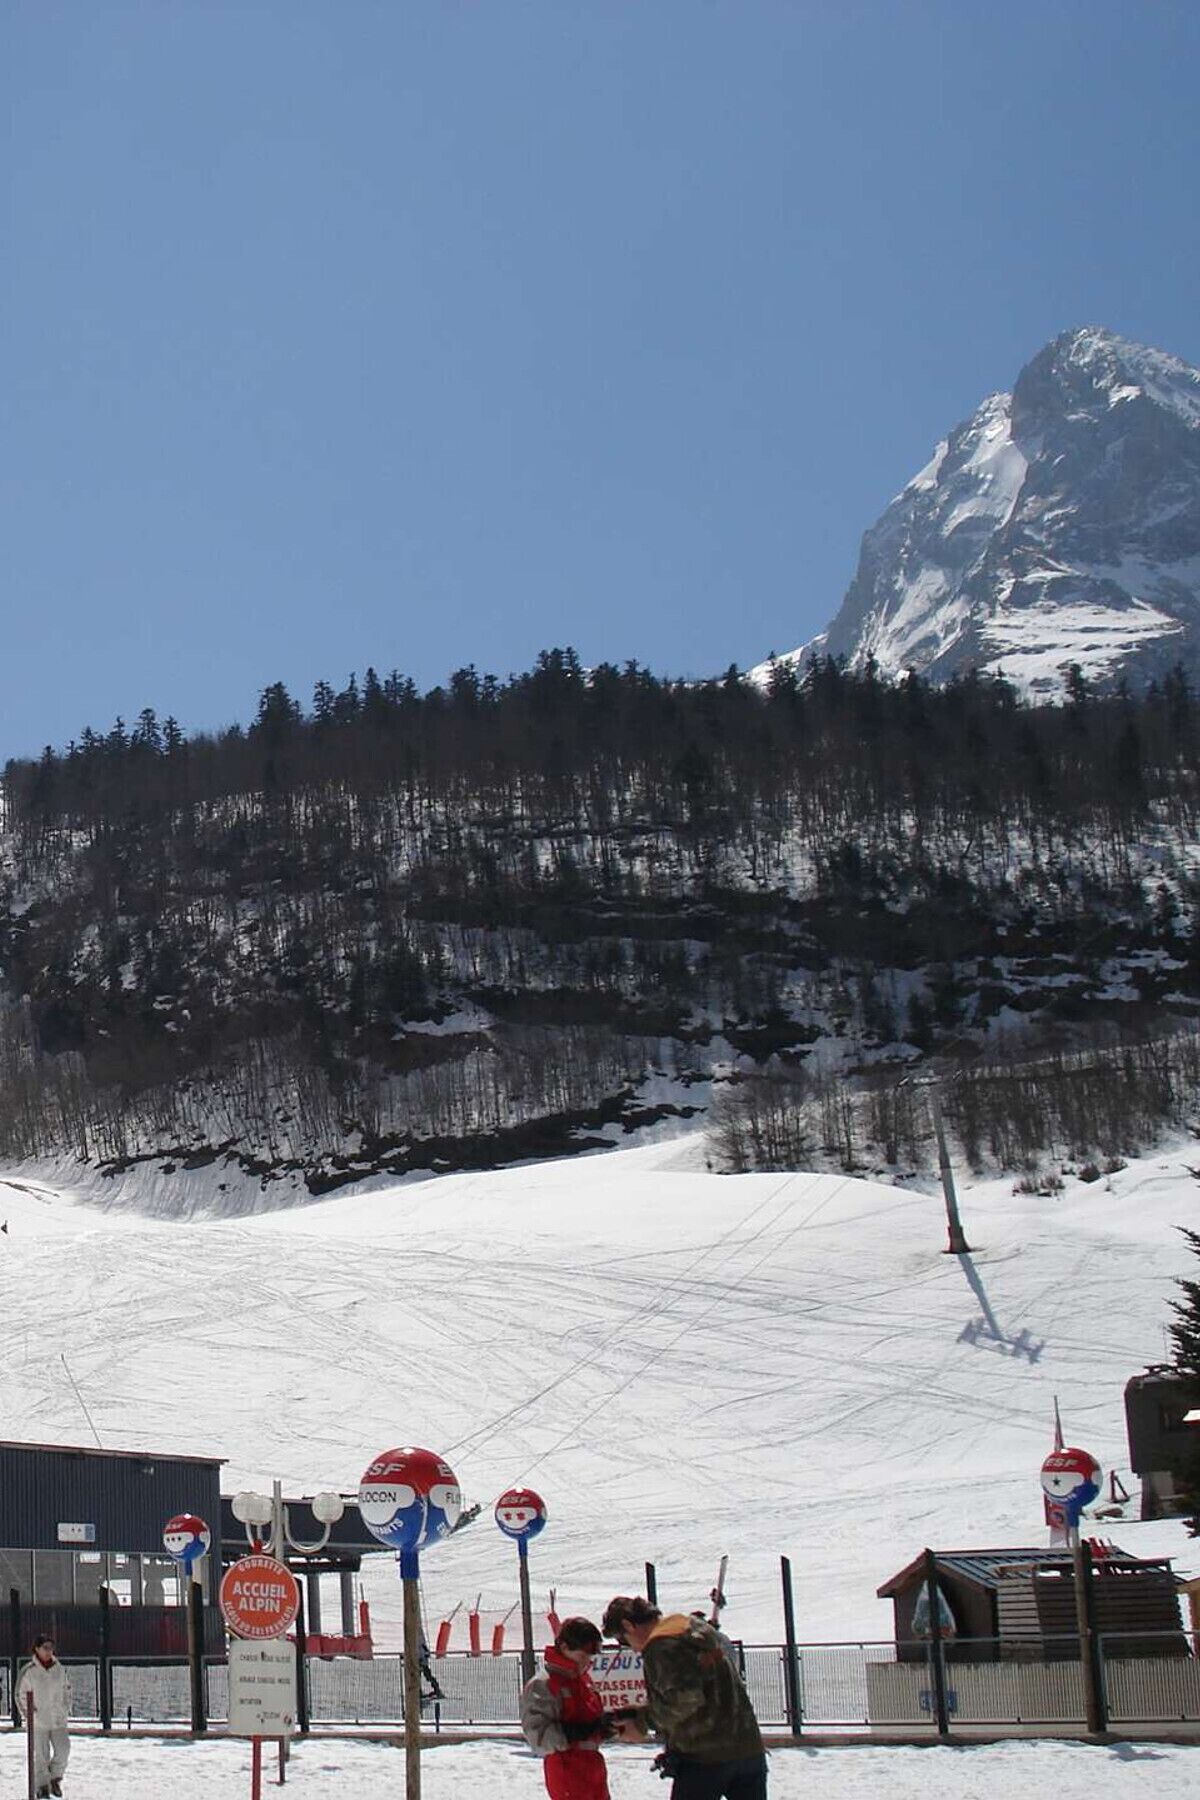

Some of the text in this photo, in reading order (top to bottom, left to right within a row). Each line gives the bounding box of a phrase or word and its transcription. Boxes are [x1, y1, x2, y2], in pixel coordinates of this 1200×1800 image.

[367, 1463, 406, 1476] SF
[233, 1580, 288, 1599] ACCUEIL
[239, 1597, 281, 1613] ALPIN
